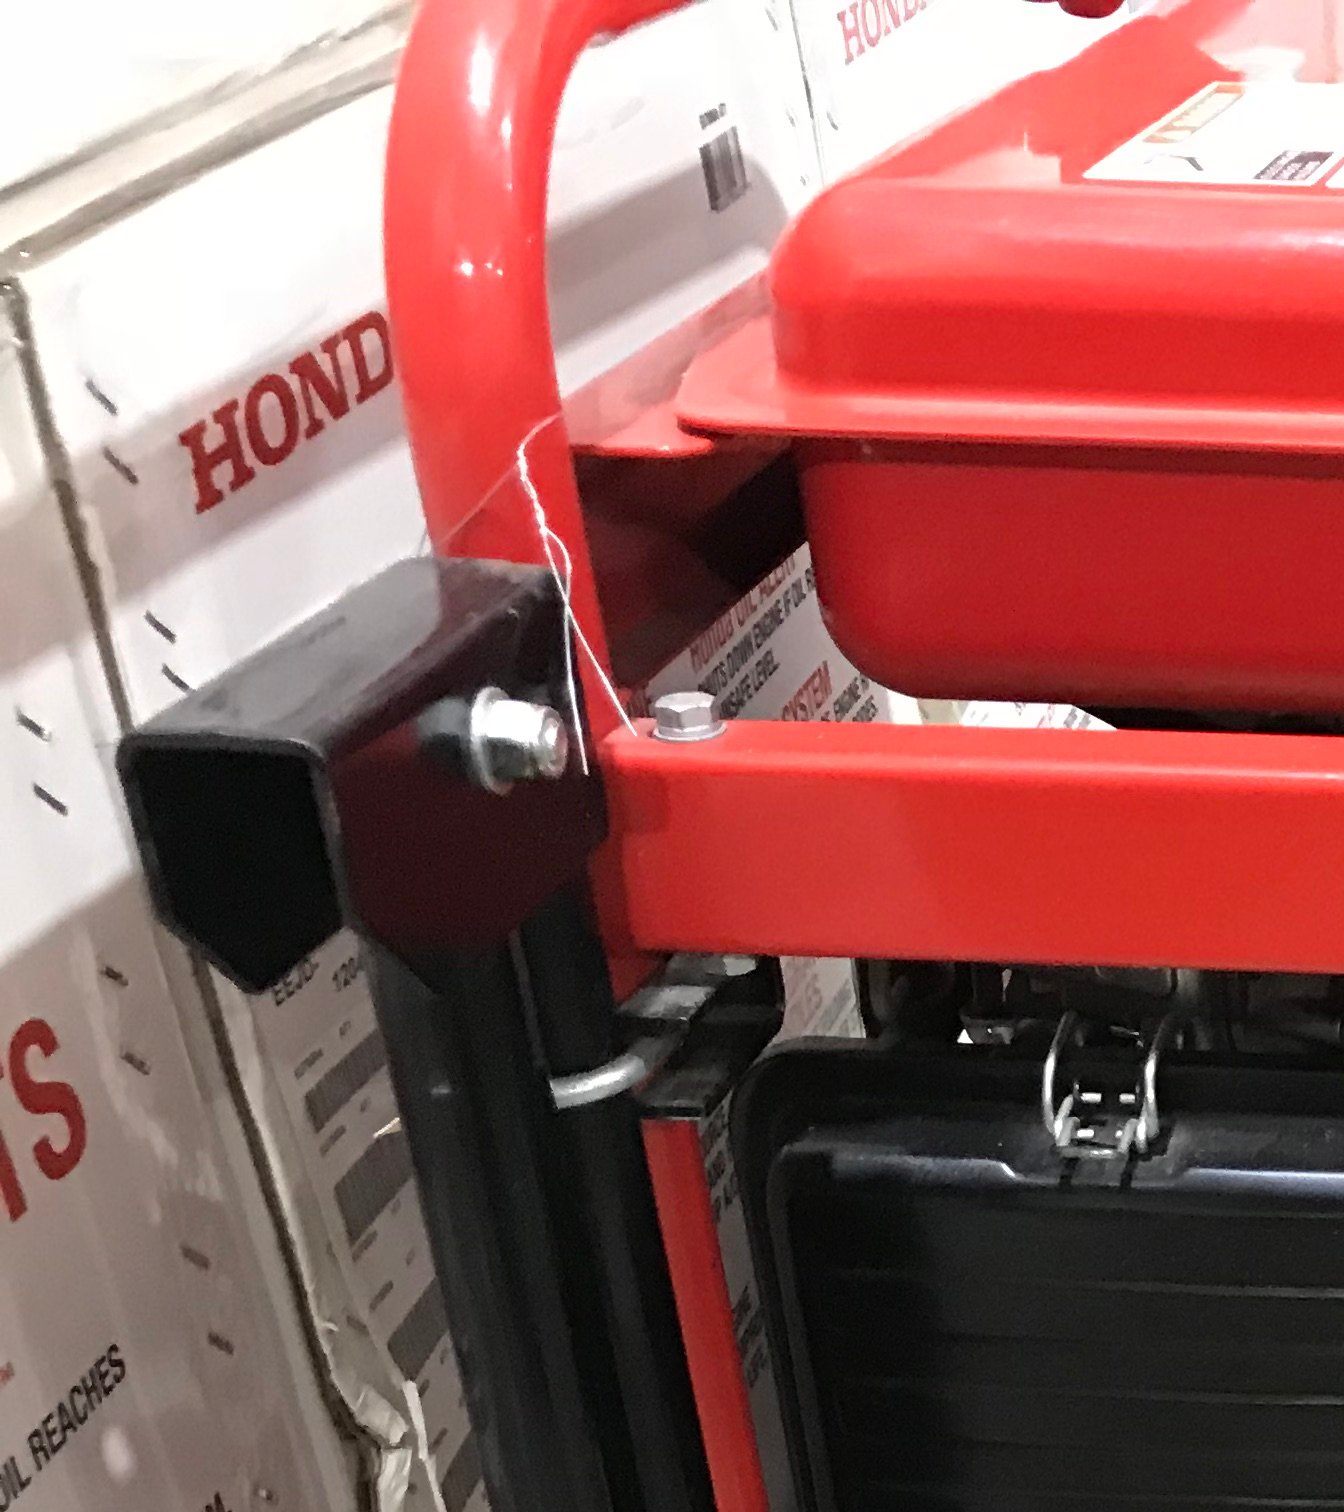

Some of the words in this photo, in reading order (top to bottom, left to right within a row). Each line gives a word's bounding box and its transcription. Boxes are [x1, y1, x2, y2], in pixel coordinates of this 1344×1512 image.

[837, 0, 927, 65] HON
[178, 310, 395, 515] HOND
[27, 1343, 126, 1472] REACHES
